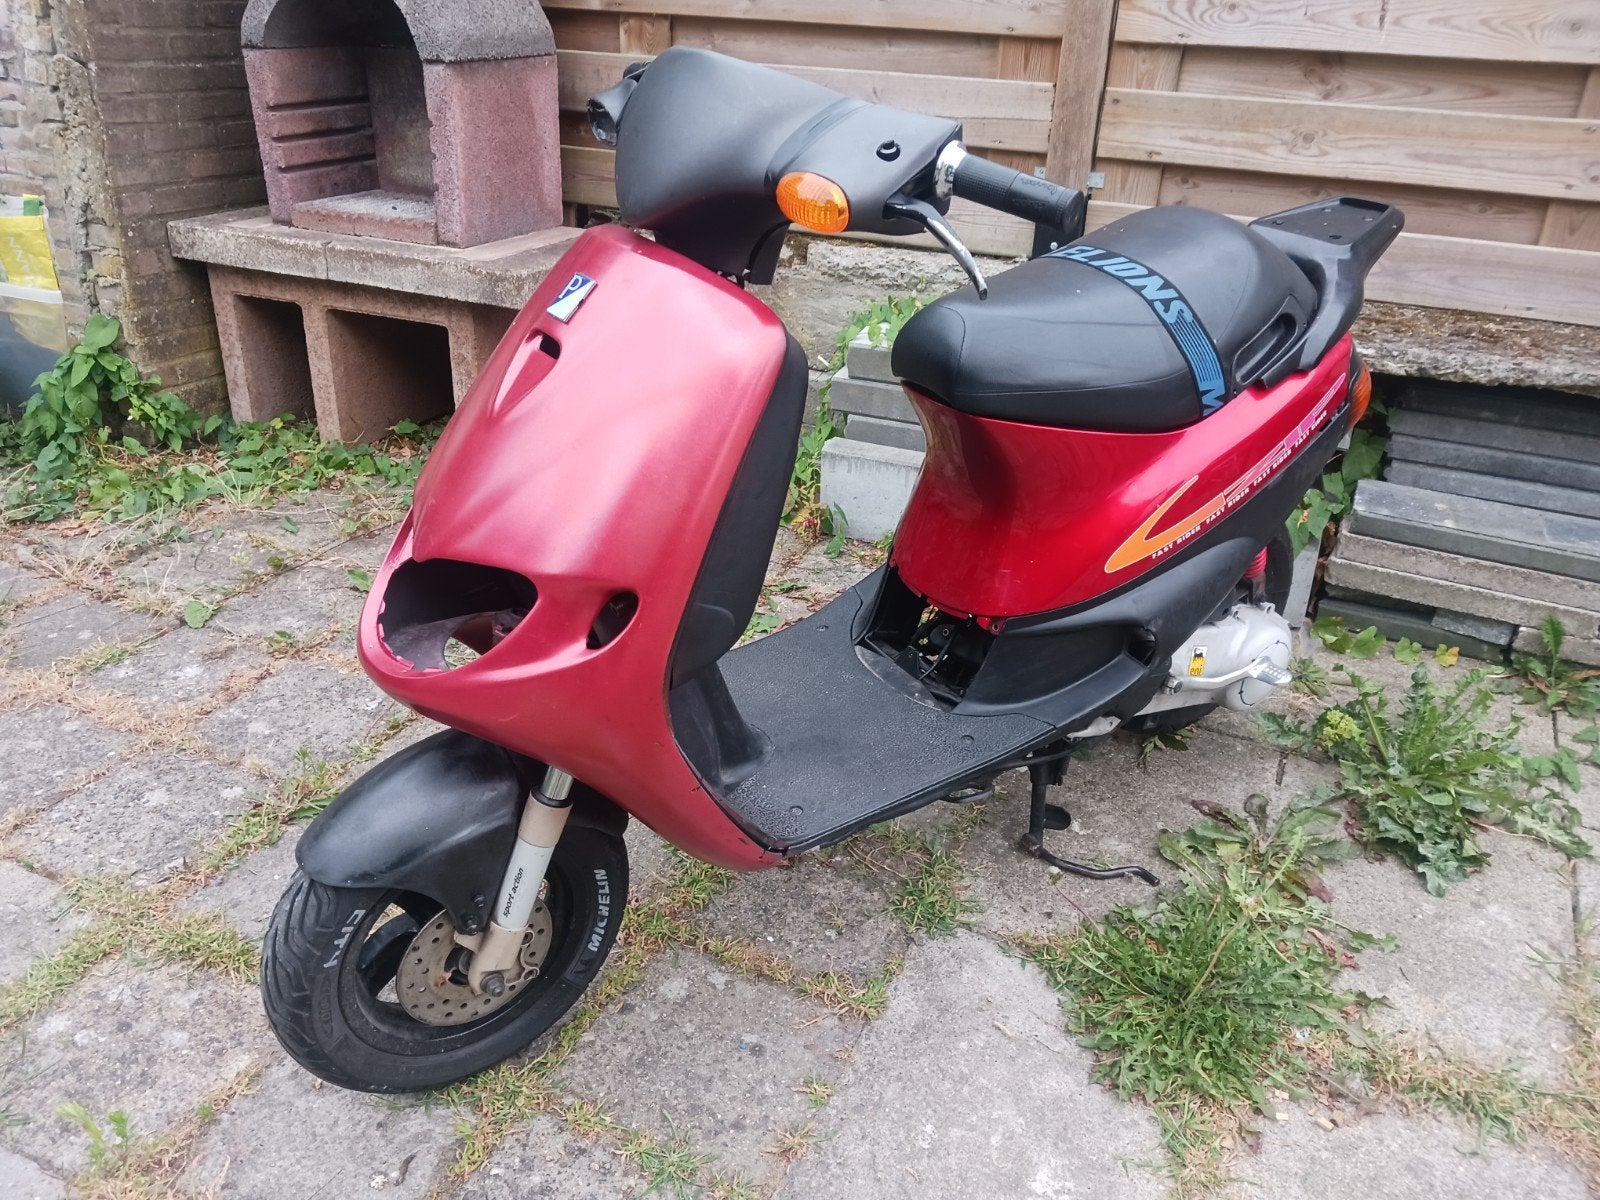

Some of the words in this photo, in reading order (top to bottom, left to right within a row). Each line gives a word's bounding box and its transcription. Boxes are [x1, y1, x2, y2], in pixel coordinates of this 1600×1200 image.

[558, 273, 584, 299] P
[1152, 542, 1174, 560] FAST
[1176, 525, 1201, 545] RIDER
[1205, 506, 1225, 525] FAST
[1227, 487, 1250, 508] RIDER
[1253, 468, 1271, 487] FAST
[1272, 448, 1292, 470] RIDER
[1294, 429, 1310, 448] FAST
[1310, 409, 1328, 431] RIDER
[502, 893, 516, 919] sport
[511, 867, 525, 894] action
[587, 868, 611, 952] MICHELIN
[323, 909, 367, 969] CITY
